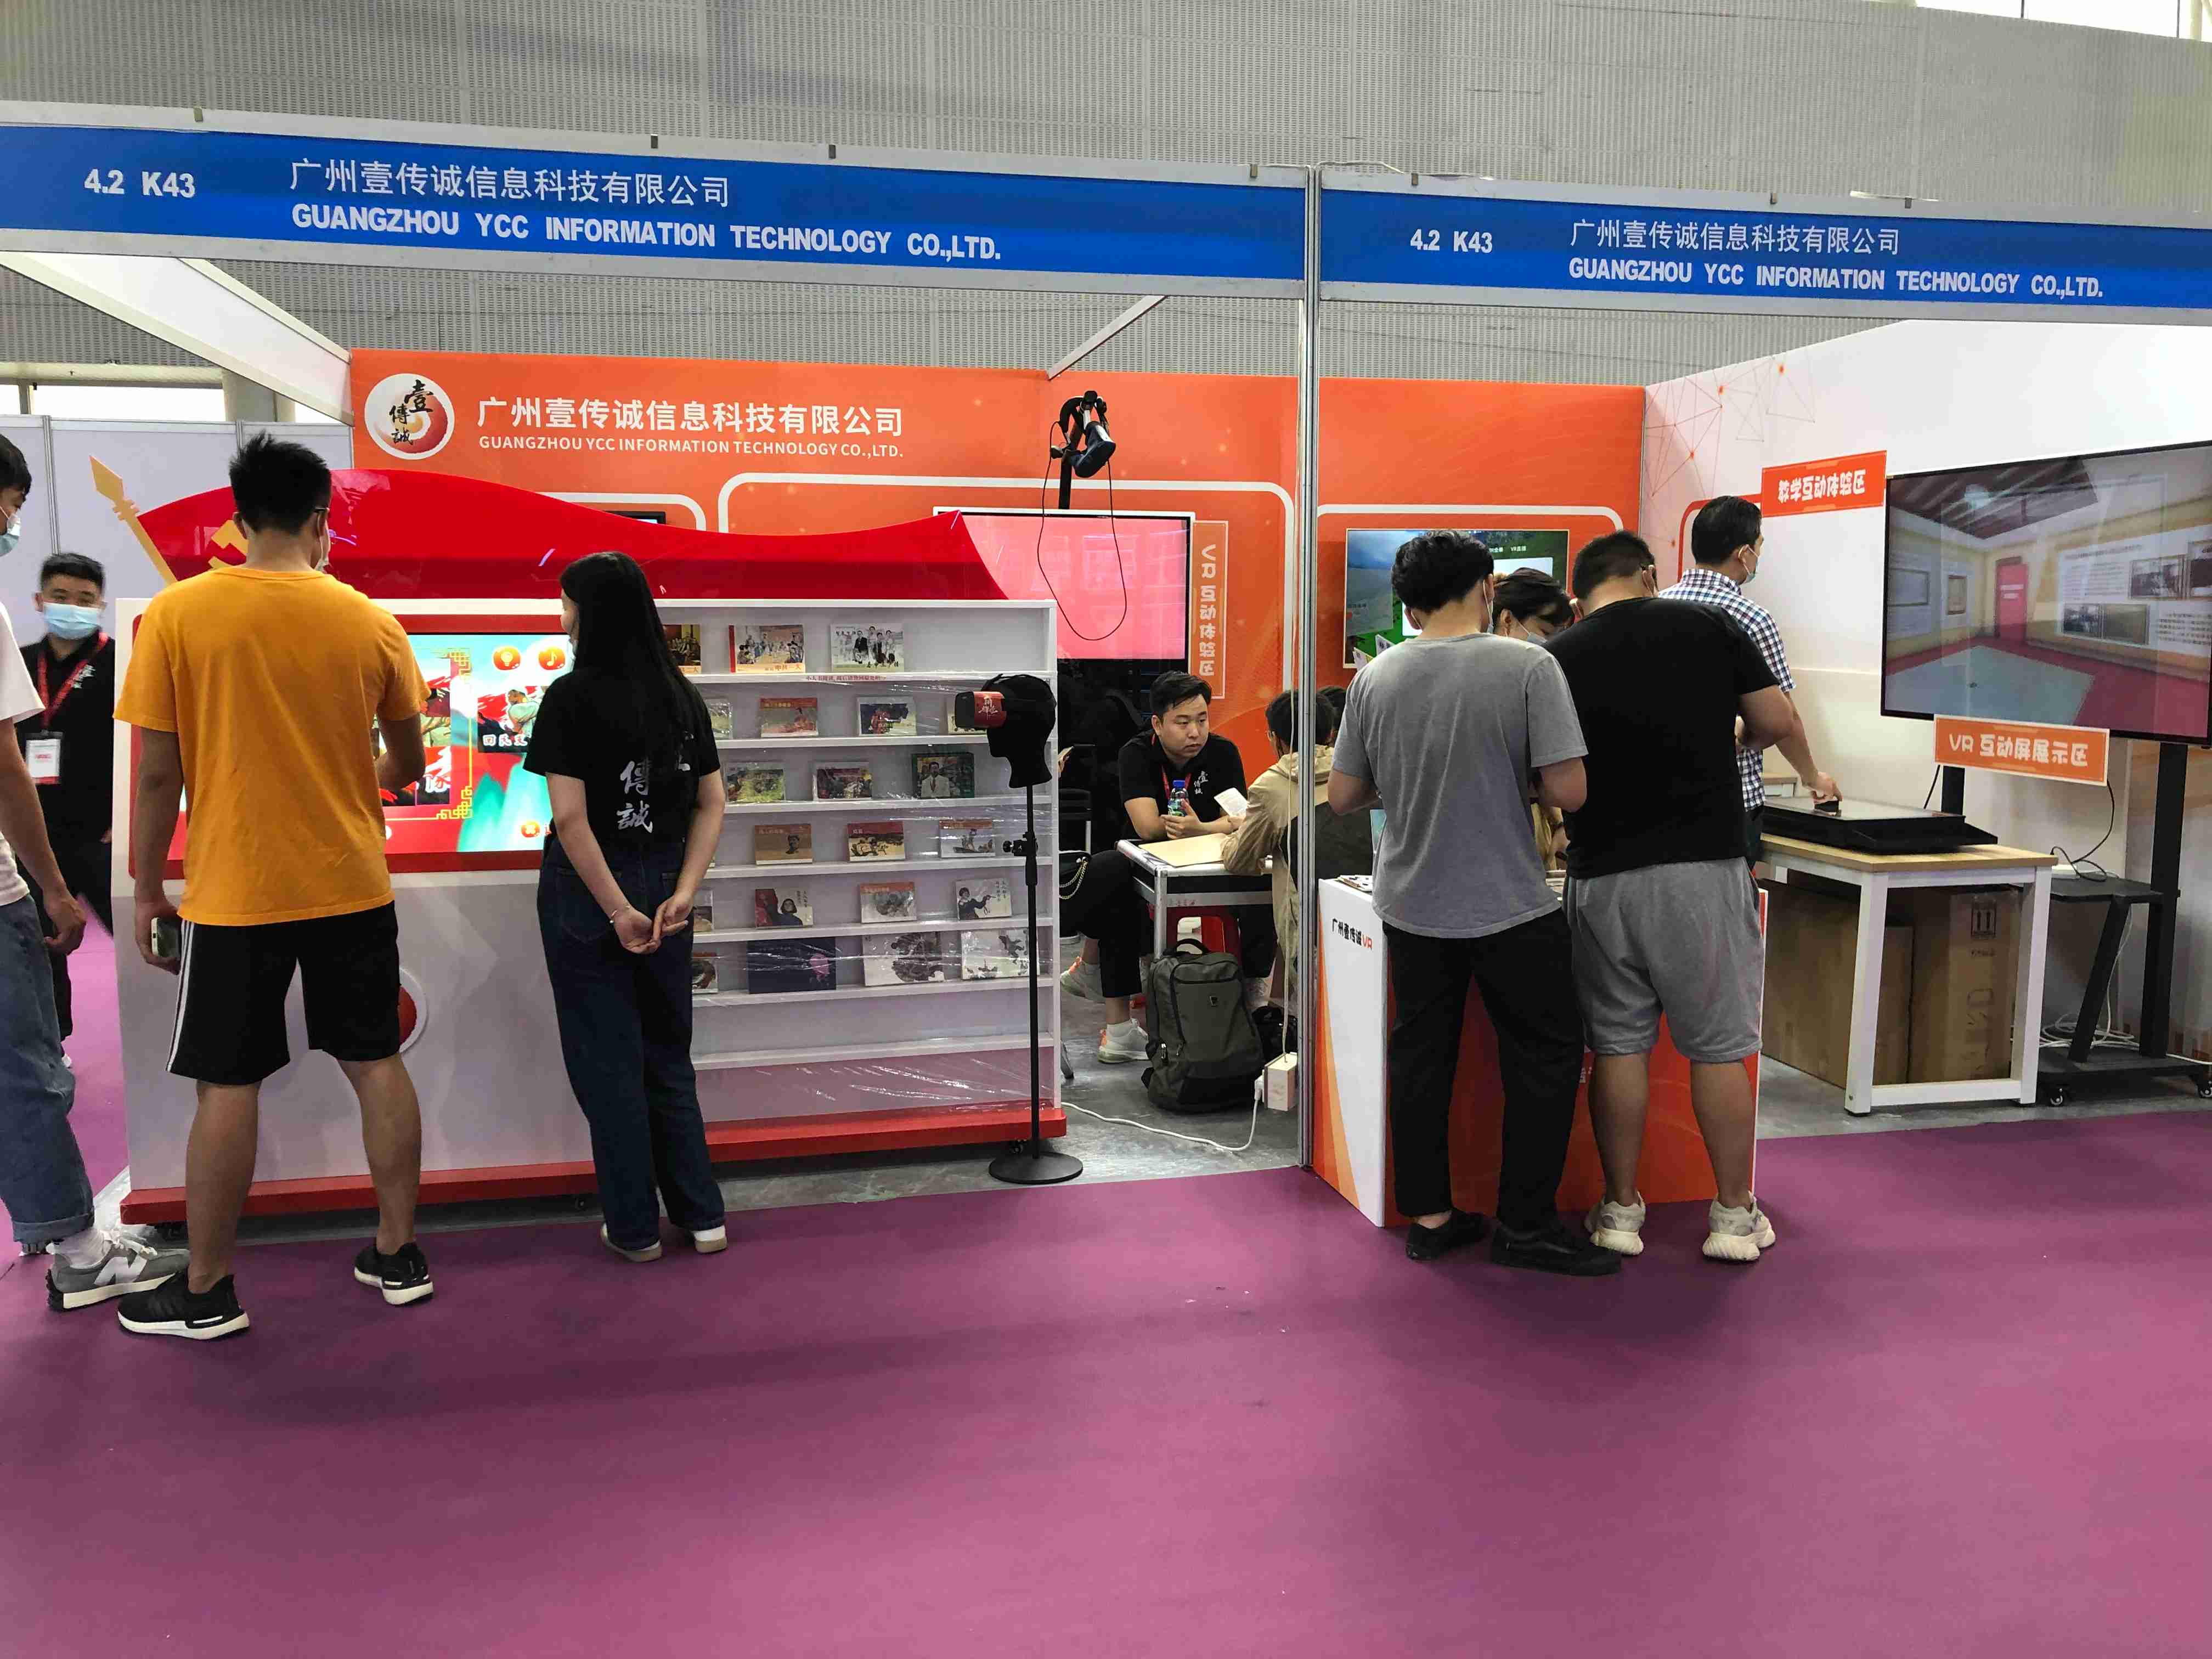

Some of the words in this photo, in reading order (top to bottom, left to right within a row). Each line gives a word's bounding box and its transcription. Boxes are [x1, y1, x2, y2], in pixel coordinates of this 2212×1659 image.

[84, 169, 125, 195] 4.2
[141, 171, 196, 198] K43
[290, 158, 730, 208] 广州壹传诚信息科技有限公司
[291, 204, 460, 235] GUANGZHOU
[475, 212, 529, 239] YCC
[545, 217, 715, 247] INFORMATION
[730, 224, 893, 255] TECHNOLOGY
[907, 233, 1001, 262] CO.,LTD.
[1410, 229, 1440, 251] 4.2
[1453, 231, 1493, 254] K43
[1570, 219, 1899, 255] 广州壹传诚信息科技有限公司
[1569, 257, 1692, 284] GUANGZHOU
[1704, 263, 1745, 285] YCC
[1756, 265, 1886, 291] INFORMATION
[1896, 270, 2020, 295] TECHNOLOGY
[2031, 274, 2103, 301] CO.,LTD.
[477, 396, 902, 437] 广州壹传诚信息科技有限公司
[478, 436, 583, 450] GUANGZHOU
[586, 438, 616, 452] YCC
[619, 438, 730, 454] INFORMATION
[733, 441, 838, 456] TECHNOLOGY
[840, 443, 904, 460] CO.,LTD.
[1778, 469, 1866, 504] 教学互动体验区
[1949, 733, 1974, 753] VR
[1979, 733, 2089, 768] 互动屏展示区
